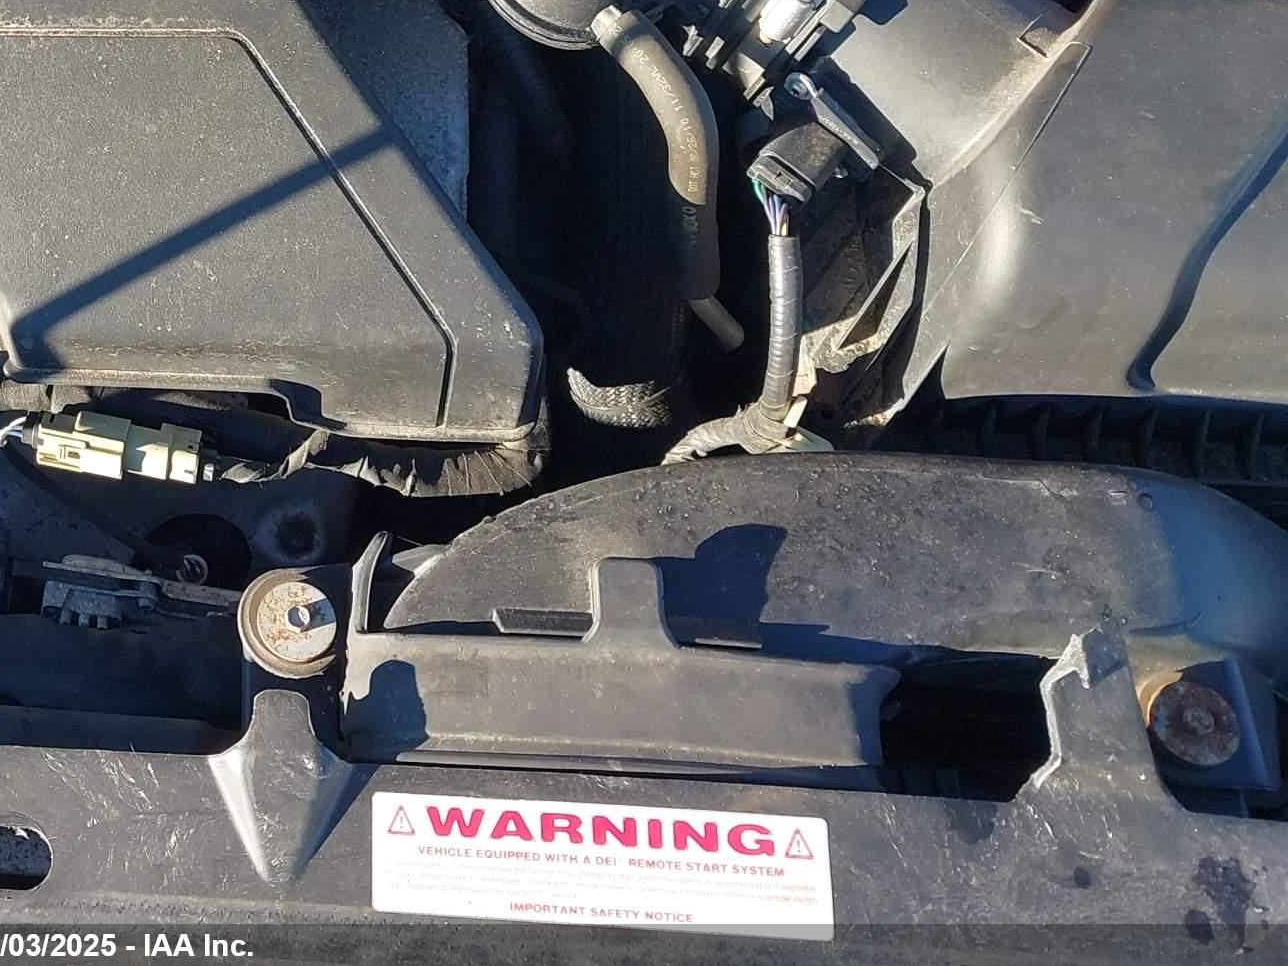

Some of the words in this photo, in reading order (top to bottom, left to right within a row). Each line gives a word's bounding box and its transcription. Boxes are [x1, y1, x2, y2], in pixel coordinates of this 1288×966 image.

[425, 805, 776, 857] WARNING
[418, 845, 472, 858] VEHICLE
[476, 849, 541, 862] EQUIPPED
[545, 853, 578, 864] WITH
[583, 855, 591, 865] A
[628, 858, 682, 871] REMOTE
[686, 862, 728, 874] START
[732, 864, 785, 877] SYSTEM
[509, 902, 586, 918] IMPORTANT
[590, 907, 640, 921] SAFETY
[645, 910, 694, 923] NOTICE
